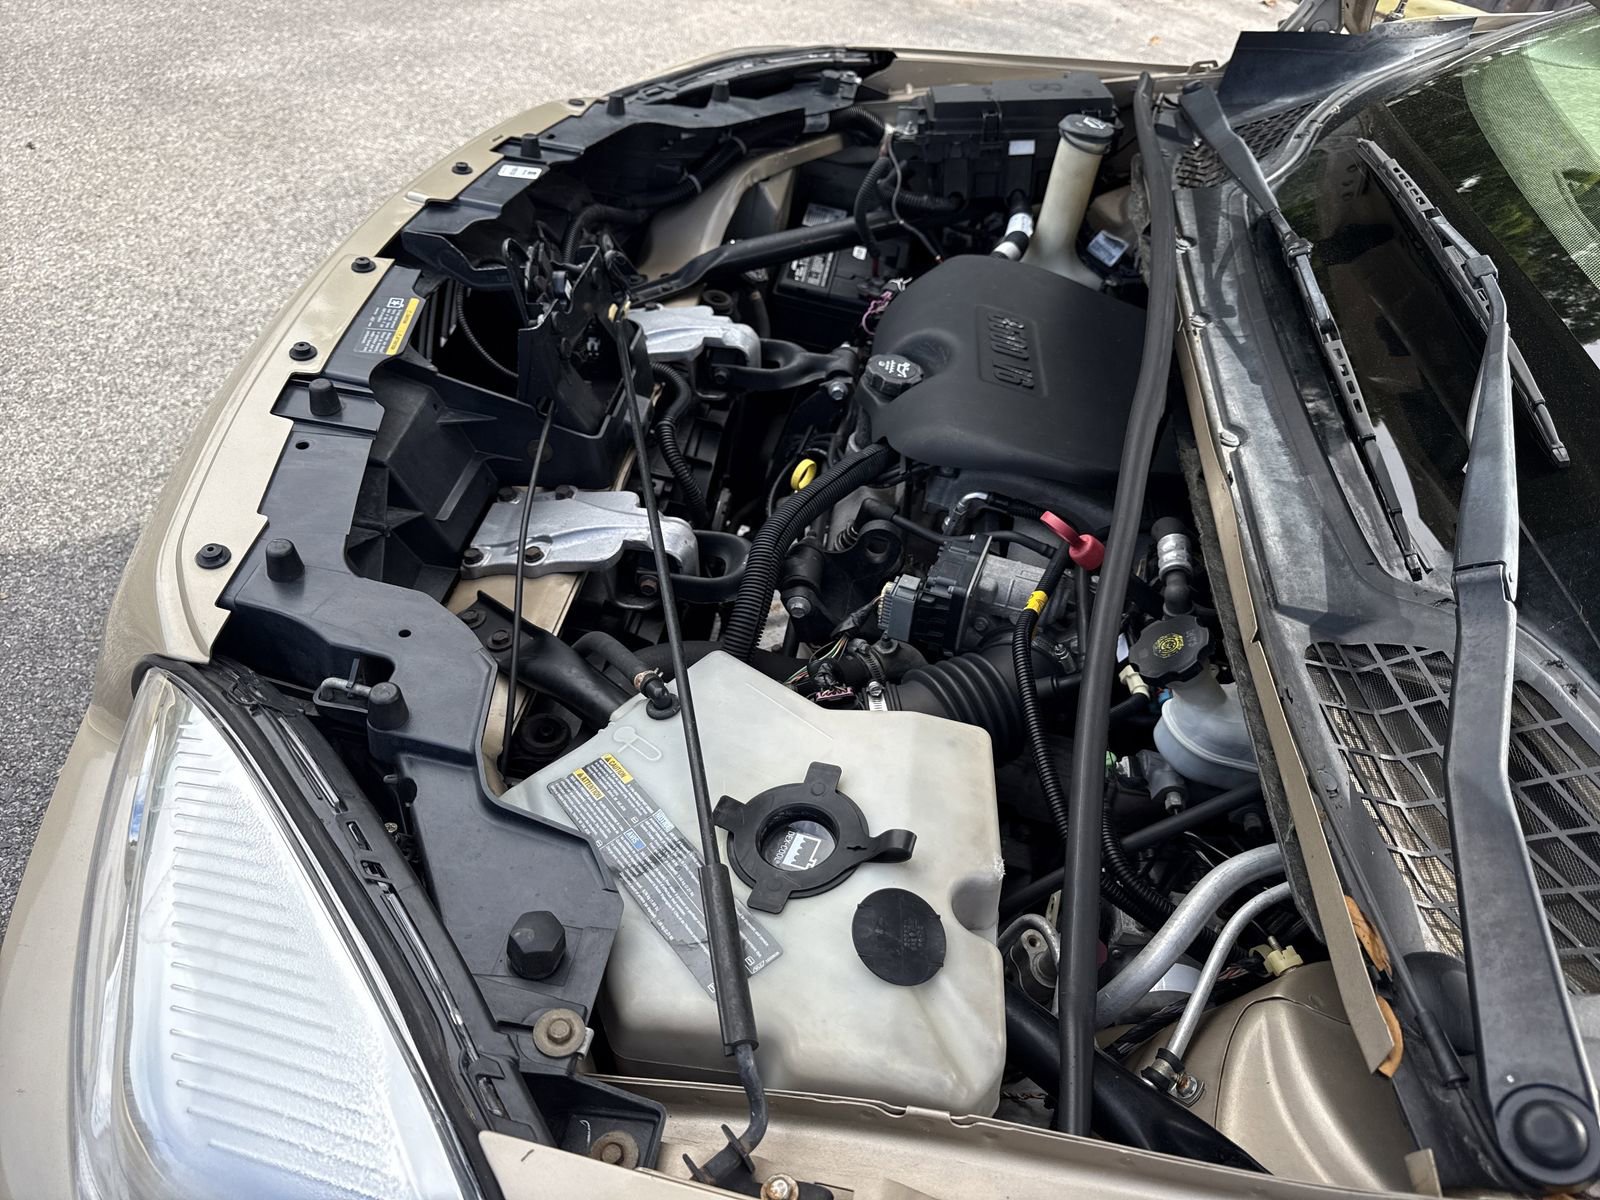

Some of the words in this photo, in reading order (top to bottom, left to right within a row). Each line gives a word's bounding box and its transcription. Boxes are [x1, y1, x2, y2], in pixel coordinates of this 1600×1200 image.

[992, 362, 1034, 390] V6
[608, 759, 627, 778] CAUTION
[581, 776, 602, 798] ATTENTION
[625, 830, 639, 844] AVIS
